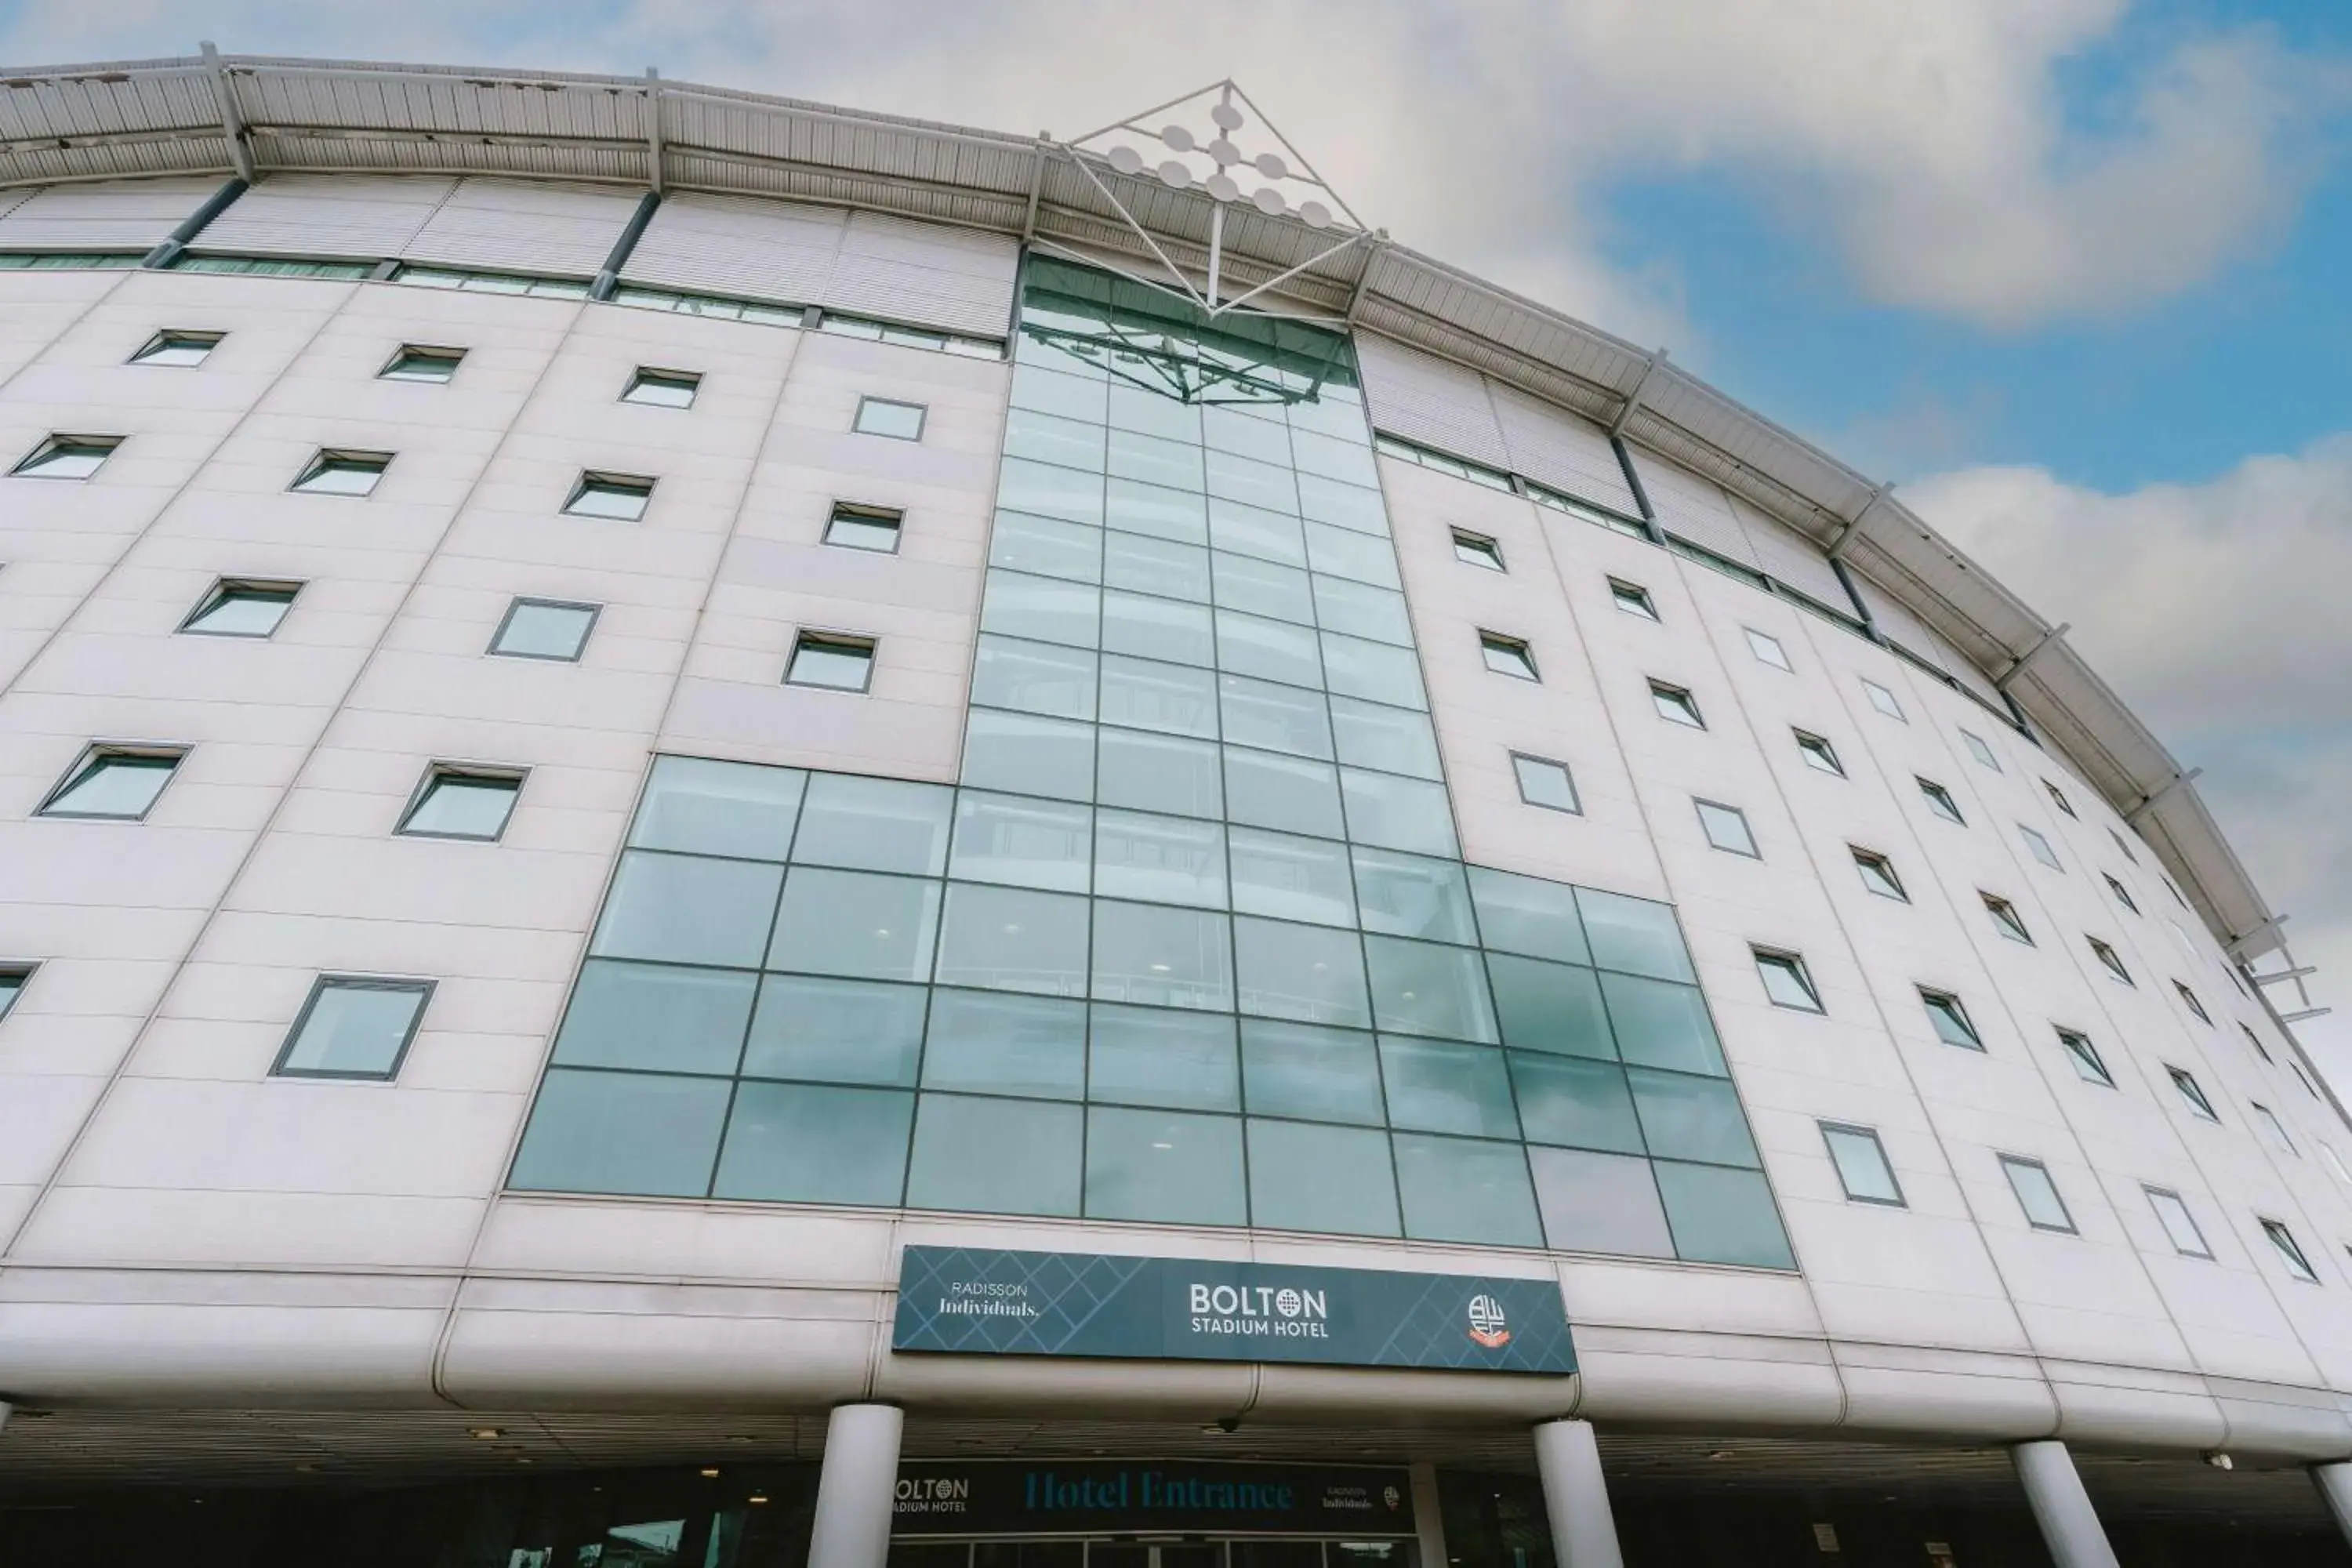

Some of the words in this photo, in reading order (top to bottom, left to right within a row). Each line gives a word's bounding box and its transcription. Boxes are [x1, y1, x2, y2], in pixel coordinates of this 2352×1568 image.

[952, 1281, 1028, 1297] RADISSON
[1191, 1283, 1327, 1319] BOLTON
[1192, 1317, 1268, 1335] STADIUM
[1274, 1322, 1329, 1338] HOTEL
[895, 1479, 969, 1500] OLTON
[1025, 1472, 1128, 1509] Hotel
[1141, 1471, 1295, 1510] Entrance
[932, 1501, 966, 1512] HOTEL
